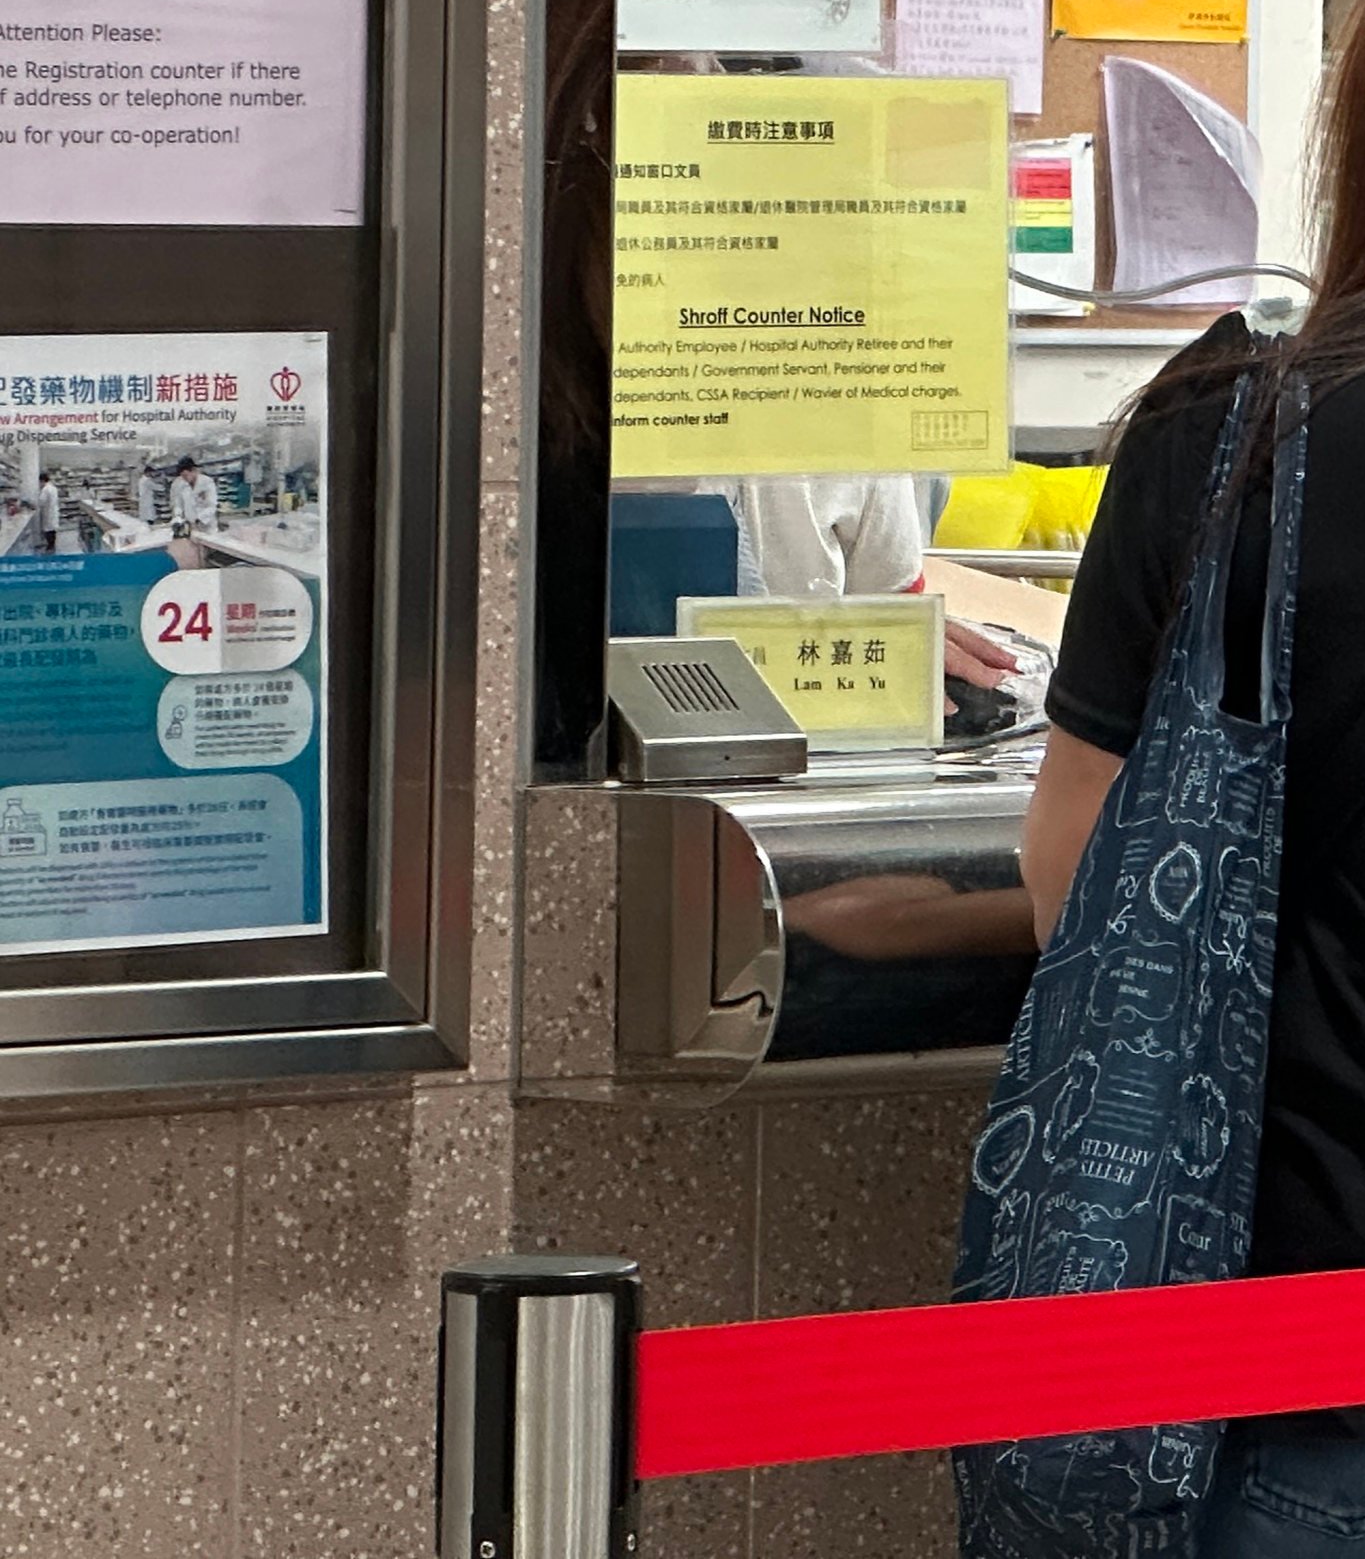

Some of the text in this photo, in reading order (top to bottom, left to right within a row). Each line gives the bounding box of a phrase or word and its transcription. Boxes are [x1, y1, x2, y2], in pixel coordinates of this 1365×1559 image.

[0, 24, 162, 42] Attention Please:
[26, 61, 300, 83] Registration counter if there
[14, 88, 307, 110] address or telephone number.
[24, 126, 241, 148] for your co-operation!
[679, 306, 866, 326] Shroff Counter Notice
[0, 374, 238, 406] 發藥物機制新措施
[15, 407, 237, 427] Arrangement for Hospital Authority
[16, 426, 137, 444] Dispensing Service
[157, 601, 214, 643] 24
[794, 676, 886, 690] Lam Ka Yu
